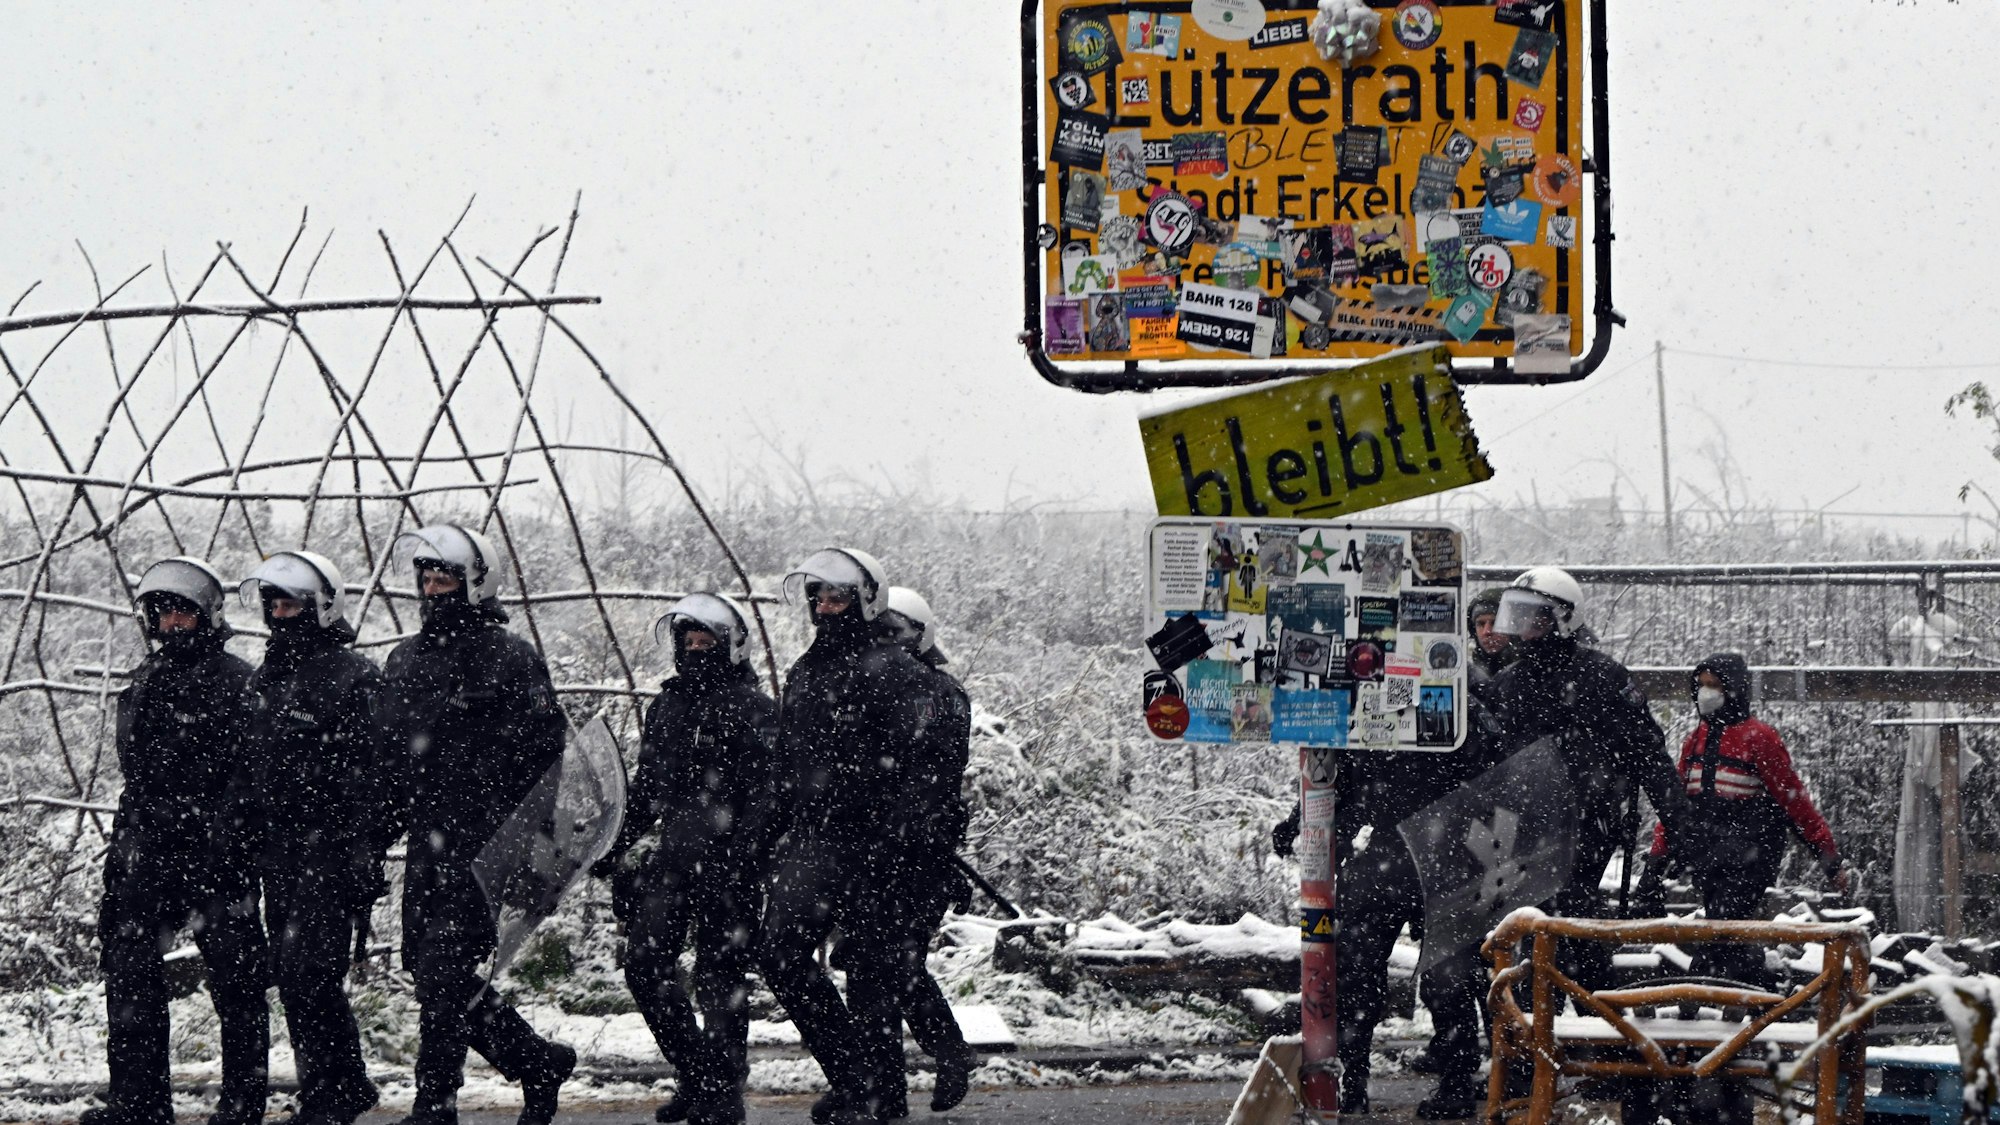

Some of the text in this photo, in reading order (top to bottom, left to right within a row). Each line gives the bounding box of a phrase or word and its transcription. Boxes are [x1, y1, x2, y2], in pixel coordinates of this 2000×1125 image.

[1253, 22, 1303, 45] LIEBE
[1104, 40, 1509, 127] Lützerath
[1122, 79, 1148, 92] FCK
[1123, 89, 1149, 105] NZS
[1062, 119, 1101, 137] TOLL
[1420, 158, 1457, 175] UNITE
[1185, 290, 1253, 313] BAHR 126
[1180, 319, 1250, 345] 126 CREW
[1337, 313, 1434, 334] BLACK LIVES MATTER
[1172, 373, 1442, 518] bleibt!
[289, 709, 315, 723] POLIZEI
